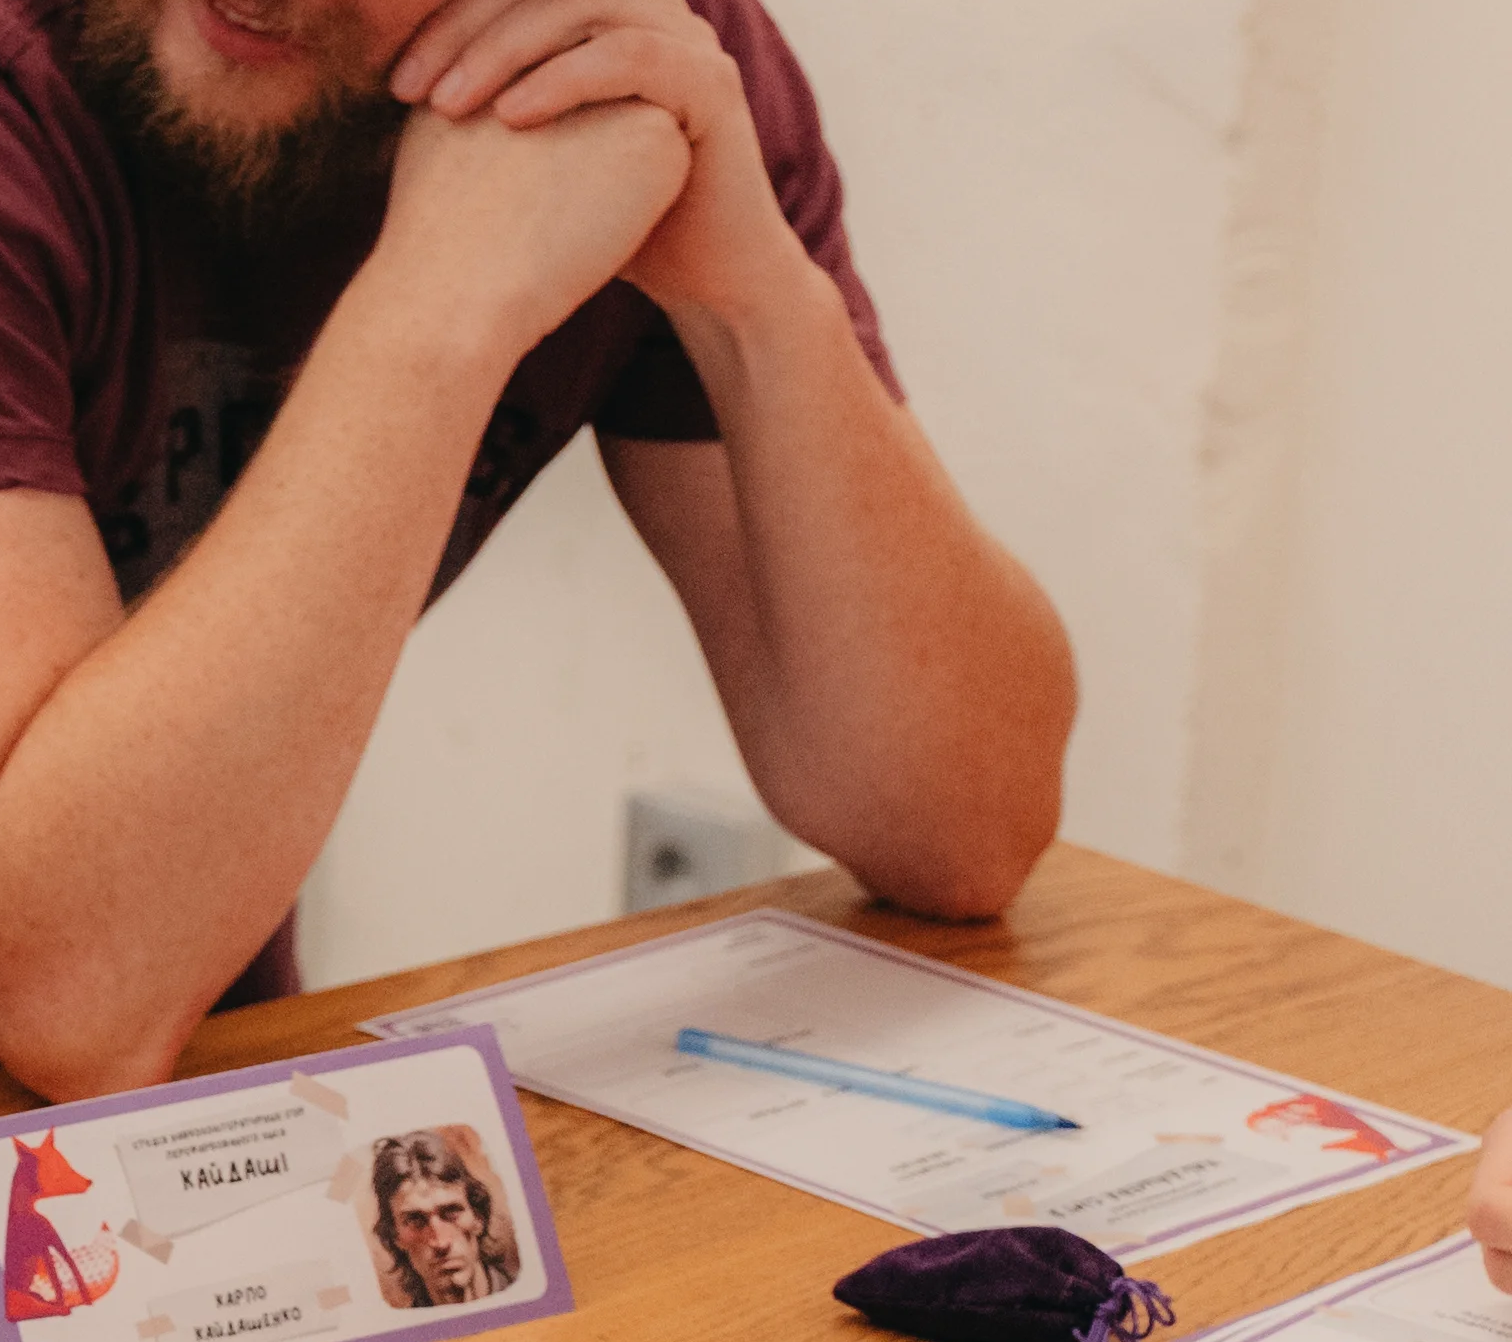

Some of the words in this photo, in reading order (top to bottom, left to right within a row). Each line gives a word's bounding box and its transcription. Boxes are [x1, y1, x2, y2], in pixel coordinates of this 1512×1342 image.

[179, 1152, 289, 1191] КАЙДАШІ
[214, 1285, 267, 1309] КАРПО
[194, 1306, 302, 1341] КАЙДАШЕНКО
